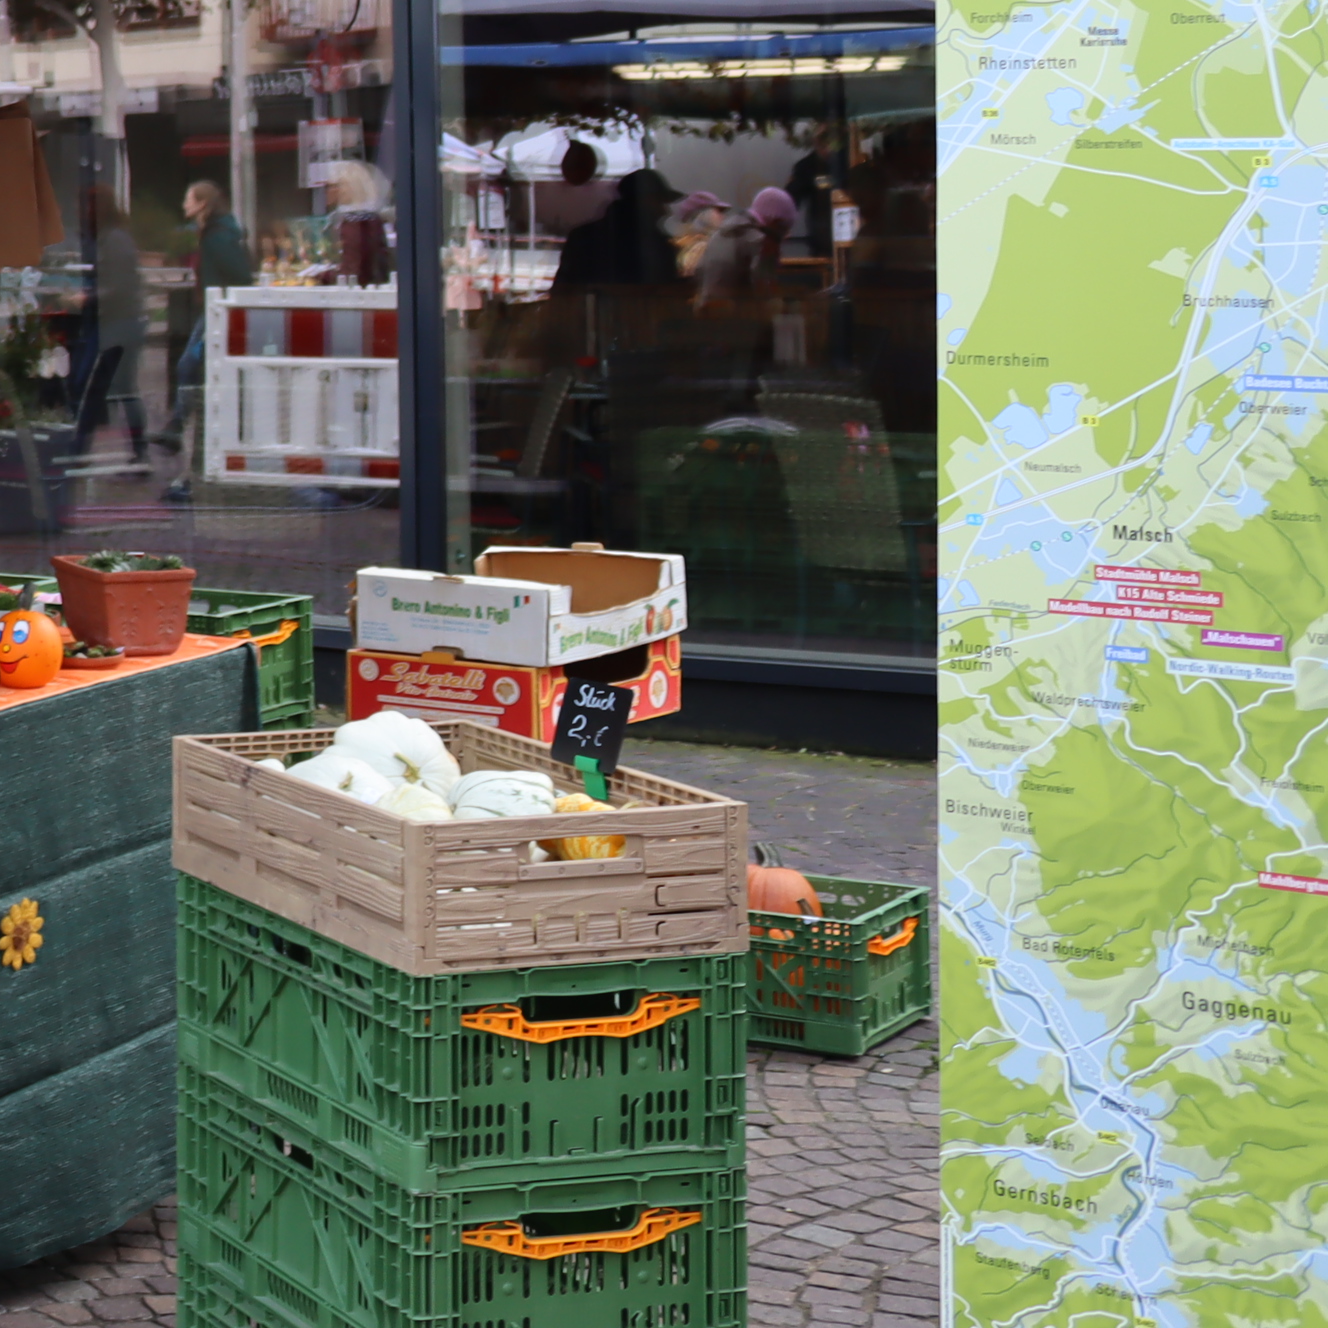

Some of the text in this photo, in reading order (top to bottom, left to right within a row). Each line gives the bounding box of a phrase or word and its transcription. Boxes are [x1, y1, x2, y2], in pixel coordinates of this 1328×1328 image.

[970, 12, 1033, 23] Forchheim
[1170, 13, 1226, 24] Oberreut
[979, 57, 1077, 70] Rheinstetten
[990, 133, 1036, 146] Mörsch
[1075, 139, 1142, 150] Silberstreifen
[1183, 295, 1274, 309] Bruchhausen
[946, 351, 1049, 368] Durmersheim
[1239, 401, 1308, 415] Oberweier
[1024, 462, 1081, 474] Neumalsch
[1271, 510, 1321, 522] Sulzbach
[1113, 526, 1173, 543] Malsch
[1118, 588, 1140, 598] K15
[1142, 589, 1165, 600] Alte
[949, 639, 1019, 658] Muggen-
[1106, 648, 1146, 661] Freibad
[949, 658, 992, 672] sturm
[380, 662, 488, 690] Sabatelli
[1031, 692, 1146, 713] Waldprechtsweier
[1022, 780, 1076, 795] Oberweier
[945, 800, 1033, 823] Bischweier
[1001, 823, 1036, 835] Winkel
[1022, 937, 1115, 962] Bad Rotenfels
[1181, 992, 1292, 1026] Gaggenau
[993, 1179, 1098, 1214] Gernsbach
[975, 1251, 1051, 1278] Staufenberg
